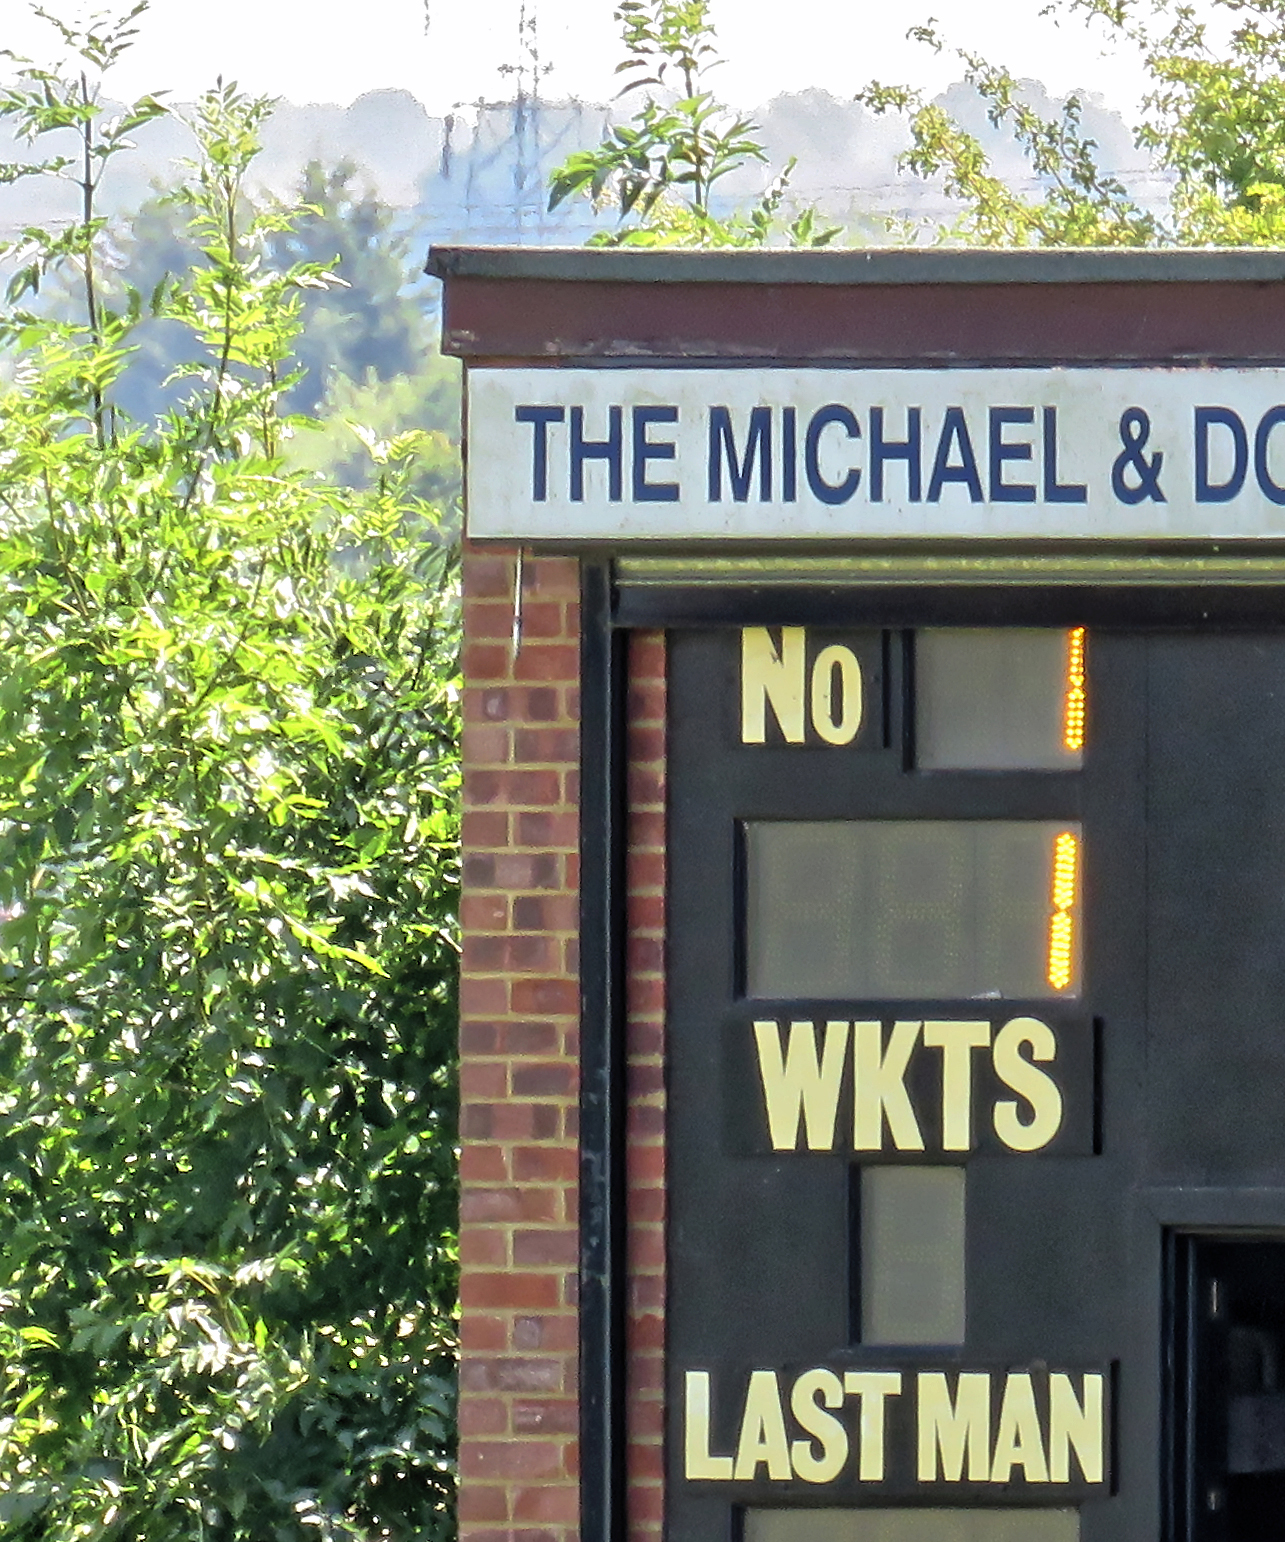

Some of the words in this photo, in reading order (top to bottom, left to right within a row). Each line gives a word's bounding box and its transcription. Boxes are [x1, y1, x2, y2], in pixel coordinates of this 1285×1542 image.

[516, 407, 679, 502] THE
[709, 406, 1086, 504] MICHAEL
[1112, 410, 1166, 504] &
[1063, 627, 1085, 749] 1
[1046, 831, 1080, 991] 1
[754, 1018, 1061, 1150] WKTS
[686, 1369, 901, 1482] LAST
[918, 1373, 1102, 1482] MAN
